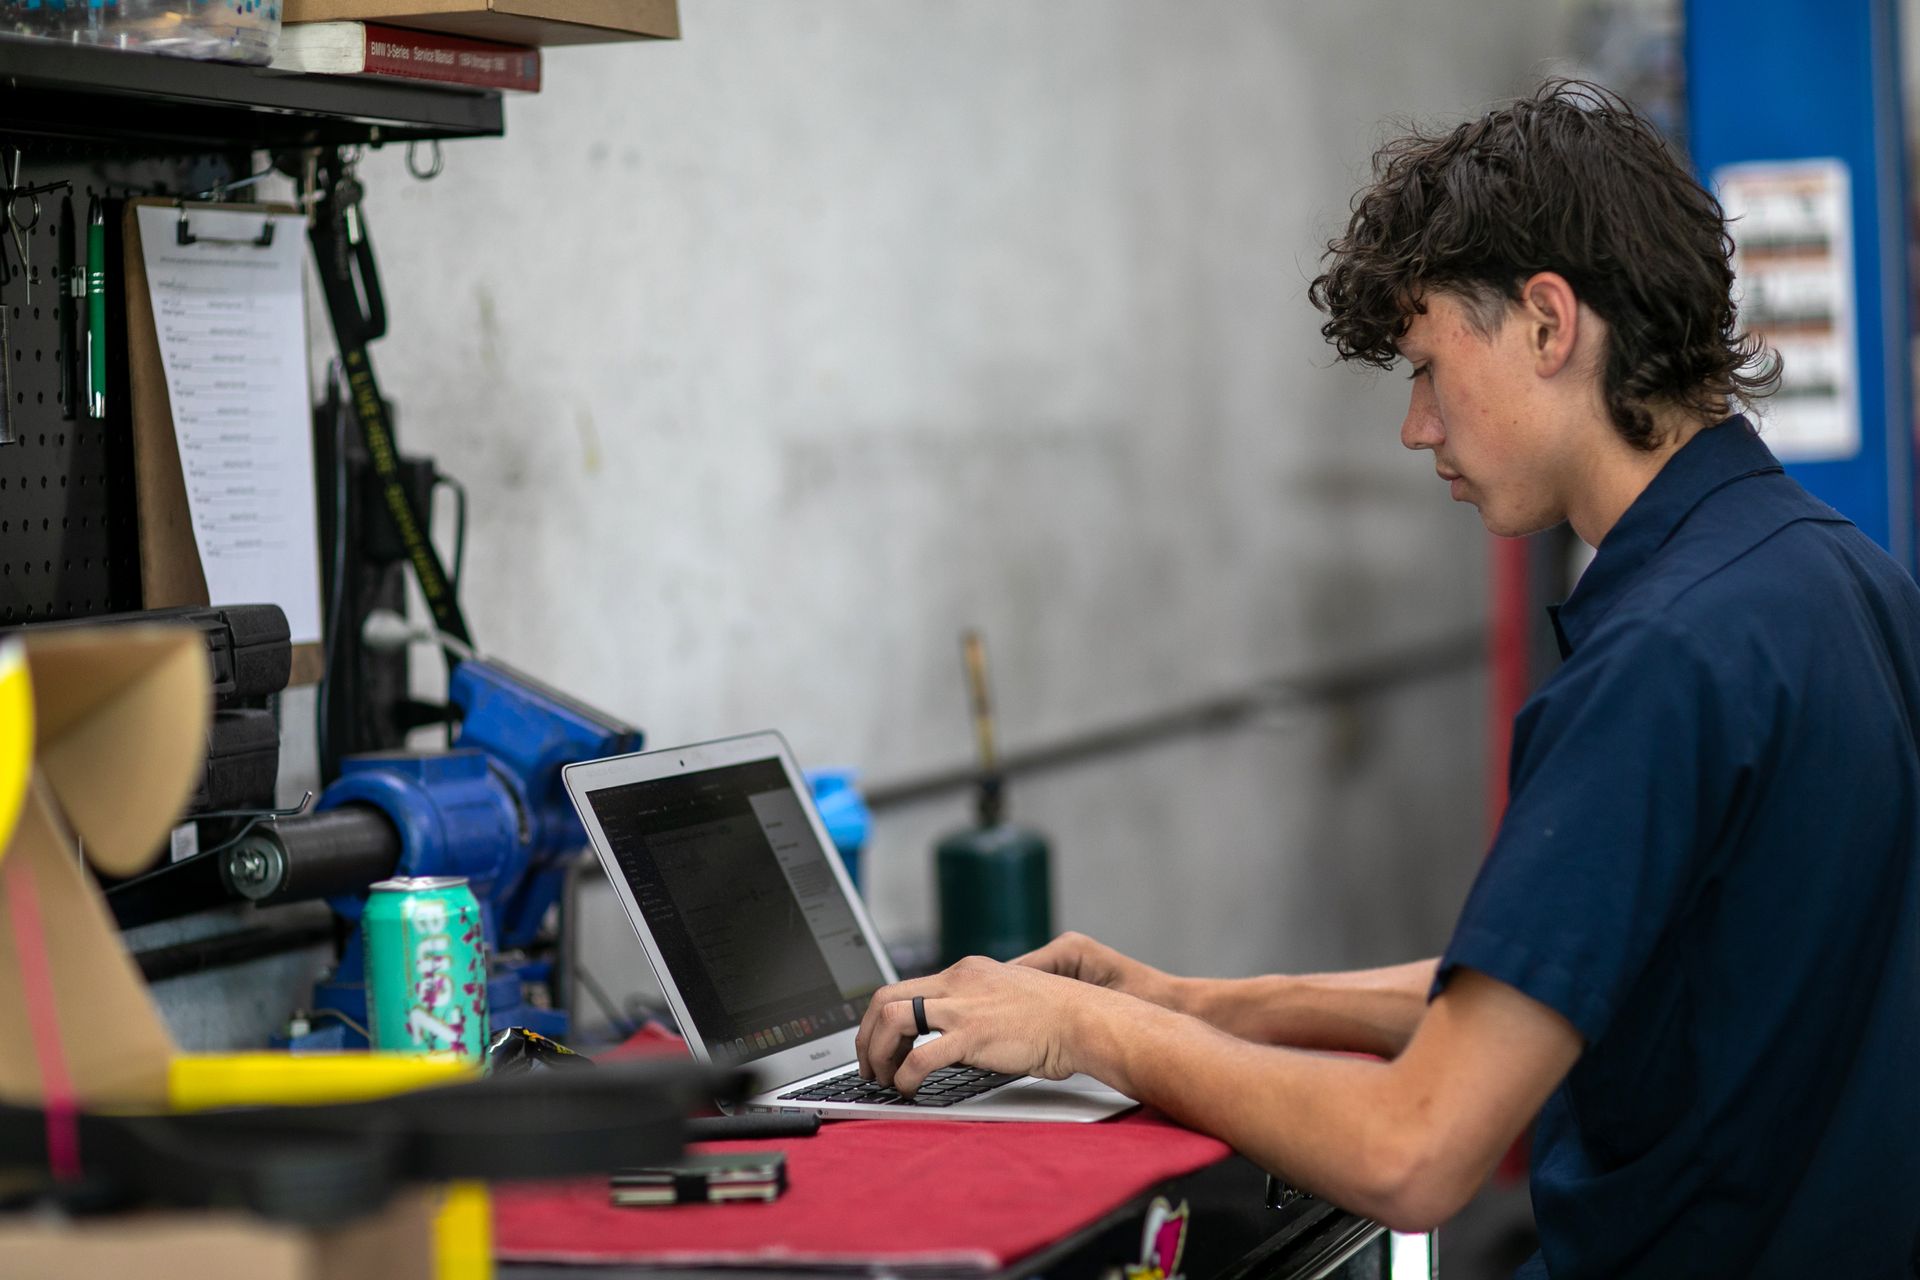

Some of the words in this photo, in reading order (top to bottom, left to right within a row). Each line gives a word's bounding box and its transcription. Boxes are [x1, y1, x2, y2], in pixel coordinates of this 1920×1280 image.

[371, 41, 386, 56] BMW
[386, 43, 410, 60] 3-Series
[413, 46, 434, 63] Service
[434, 49, 455, 65] Manual
